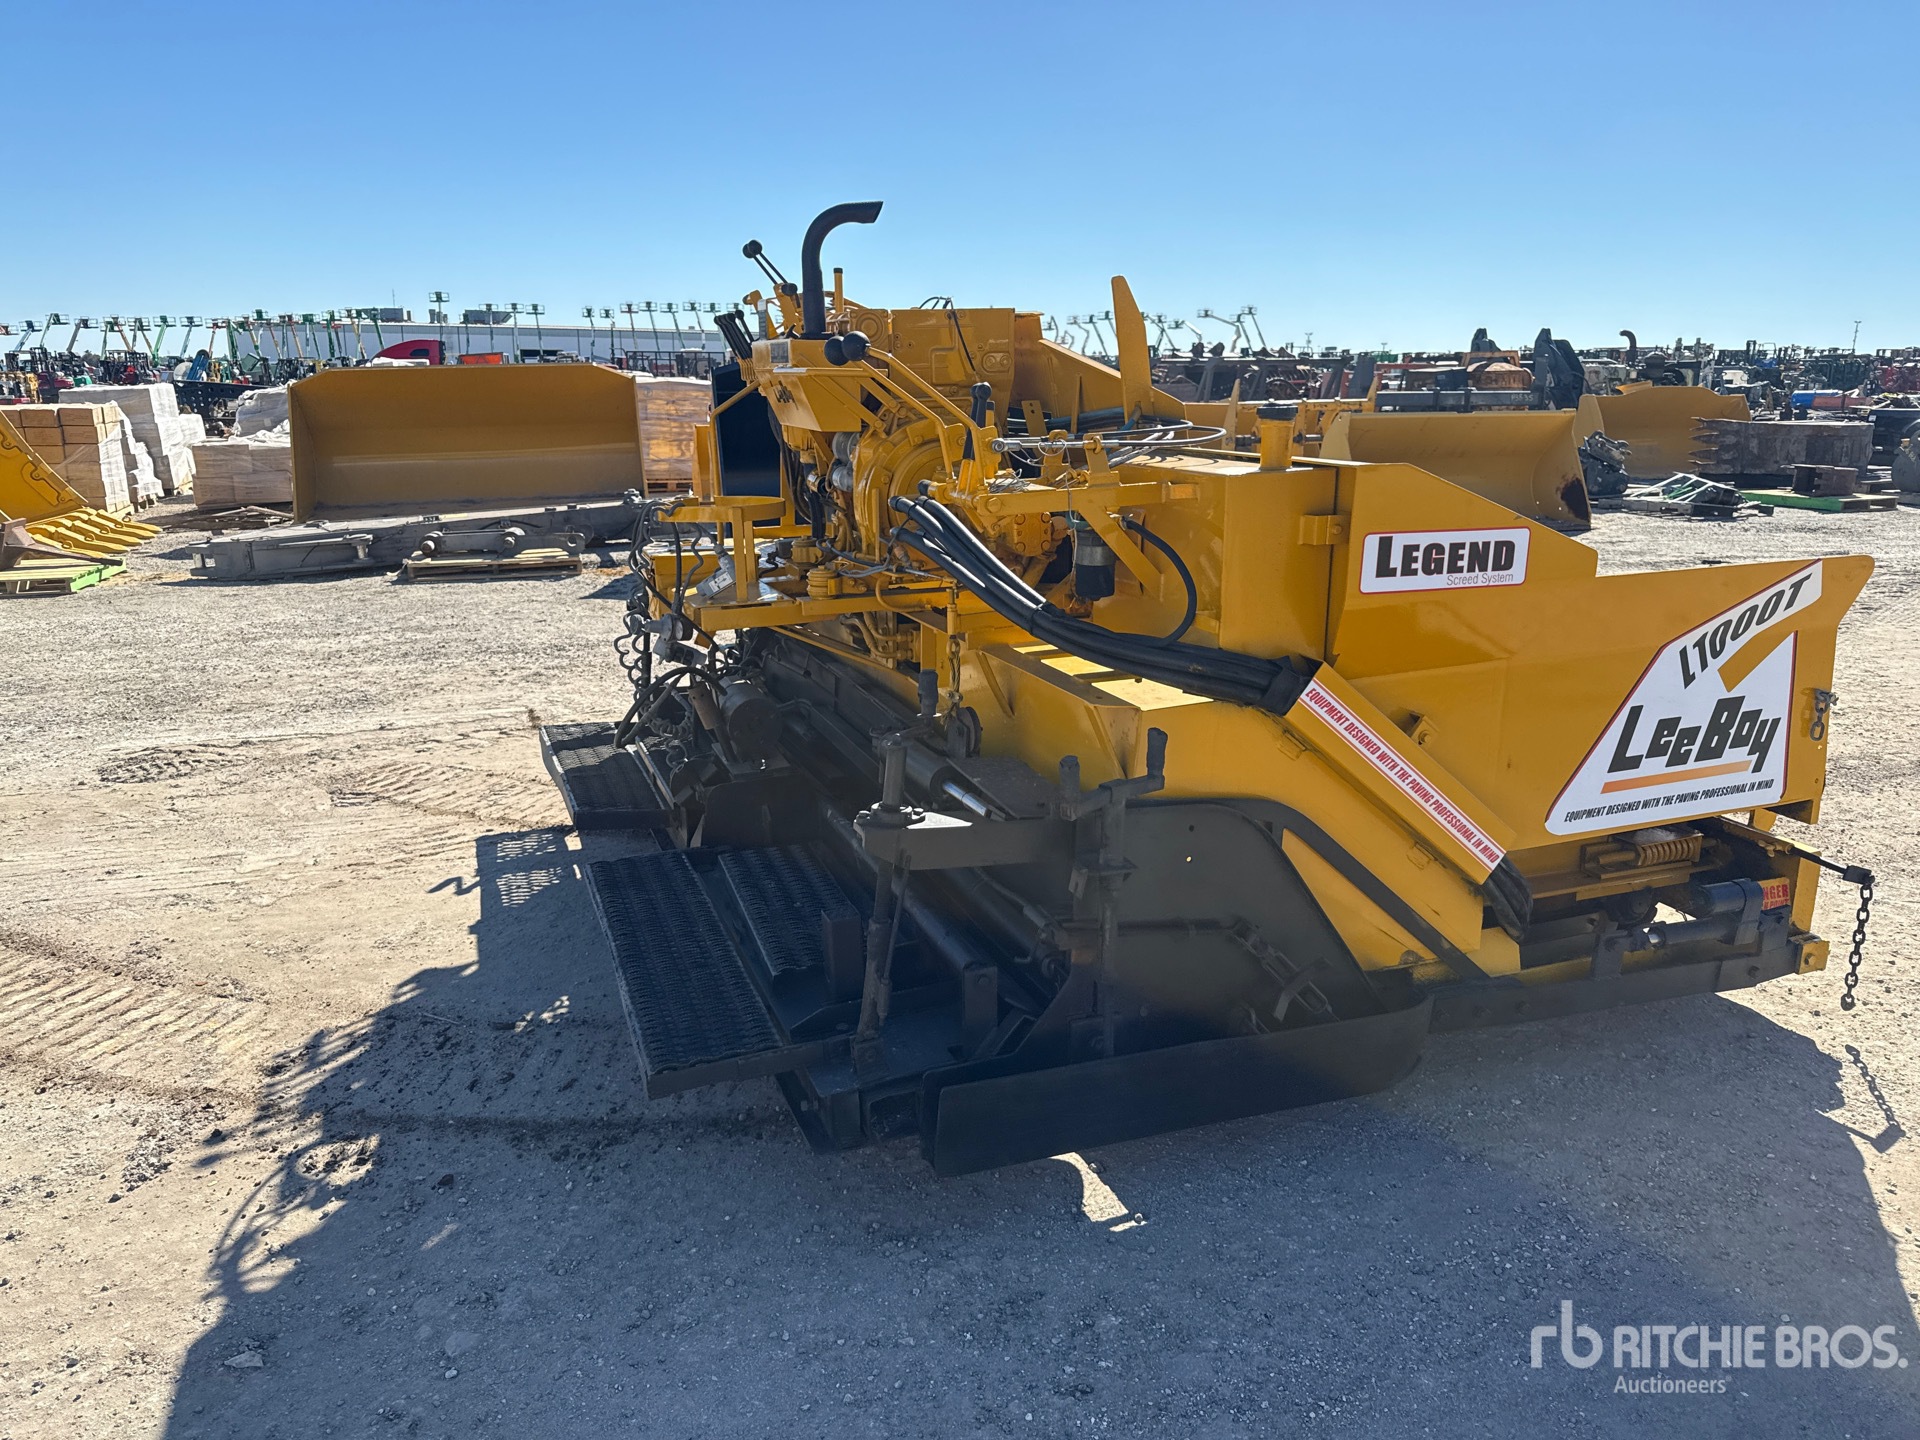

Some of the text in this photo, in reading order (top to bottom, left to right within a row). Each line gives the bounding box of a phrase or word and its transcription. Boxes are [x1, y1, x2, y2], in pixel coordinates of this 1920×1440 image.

[1375, 536, 1516, 578] LEGEND
[1446, 572, 1514, 587] Screed System
[1679, 572, 1812, 689] L1000T
[1607, 695, 1781, 774] LeeBoy
[1305, 687, 1500, 864] EQUIPMENT DESIGNED WITH THE PAVING PROFESSIONAL IN MIND
[1564, 779, 1775, 822] EQUIPMENT DESIGNED WITH THE PAVING PROFESSIONAL IN MIND
[1762, 884, 1789, 900] NGER
